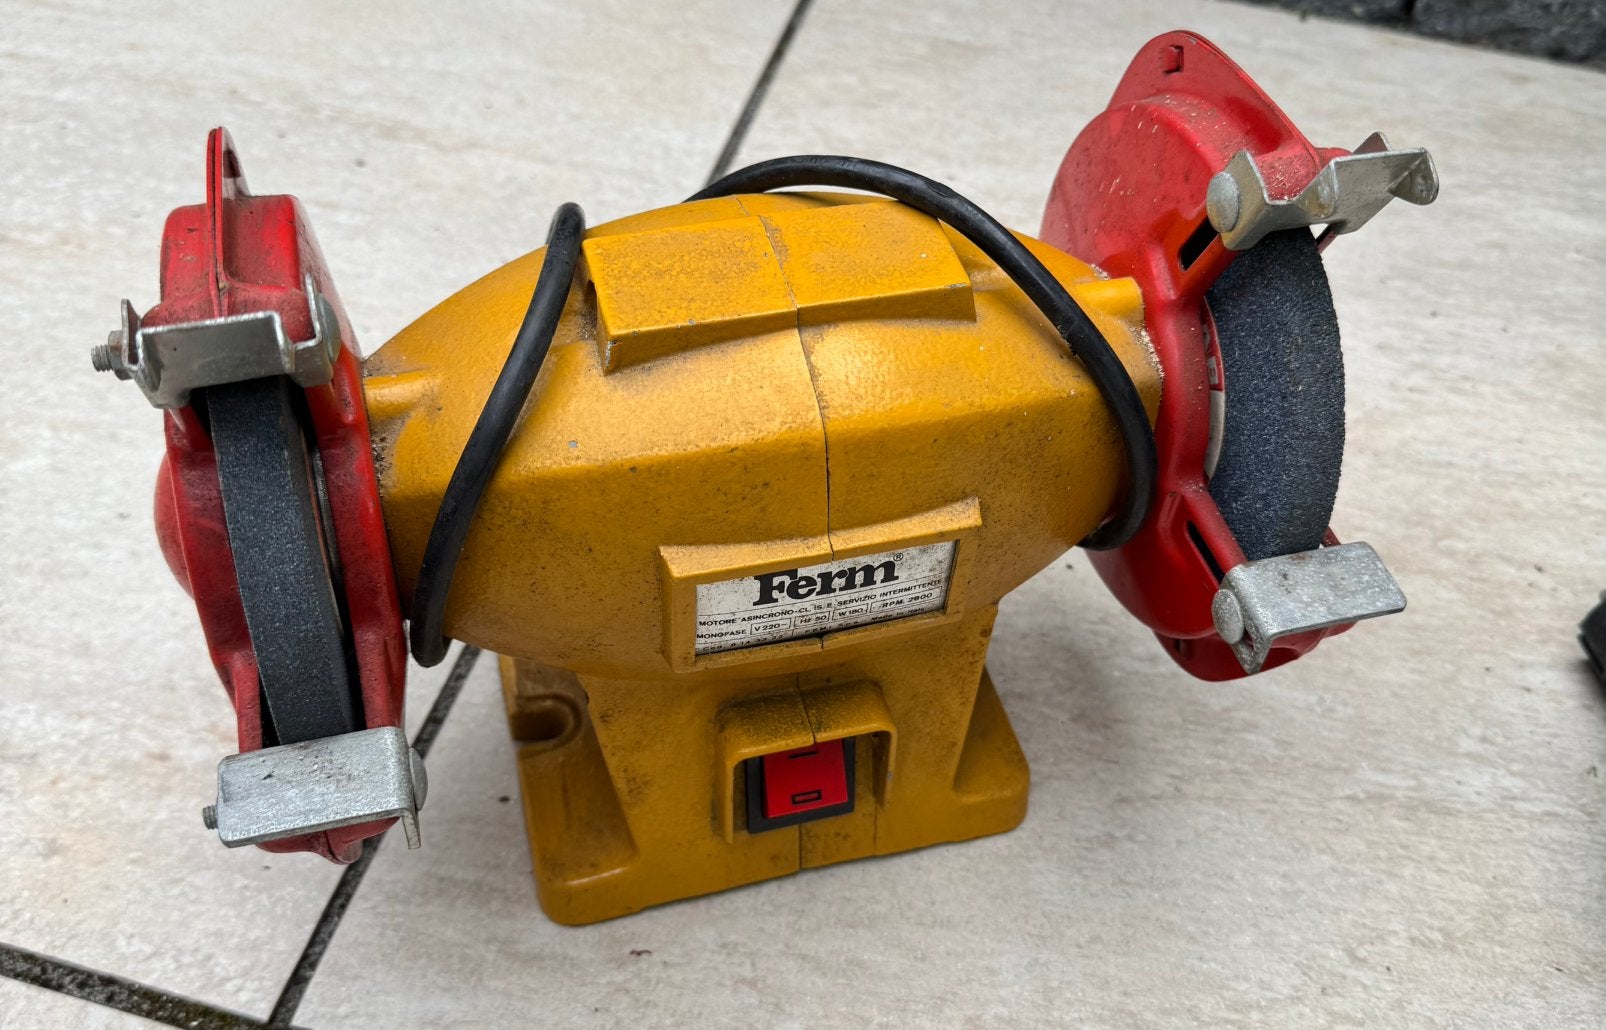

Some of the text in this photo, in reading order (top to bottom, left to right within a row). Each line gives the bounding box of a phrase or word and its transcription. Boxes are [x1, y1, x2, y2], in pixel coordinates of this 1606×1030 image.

[752, 560, 900, 606] Ferm
[698, 618, 738, 627] MOTORE
[837, 593, 877, 606] SERVIZIO
[696, 628, 747, 639] MONOFASE
